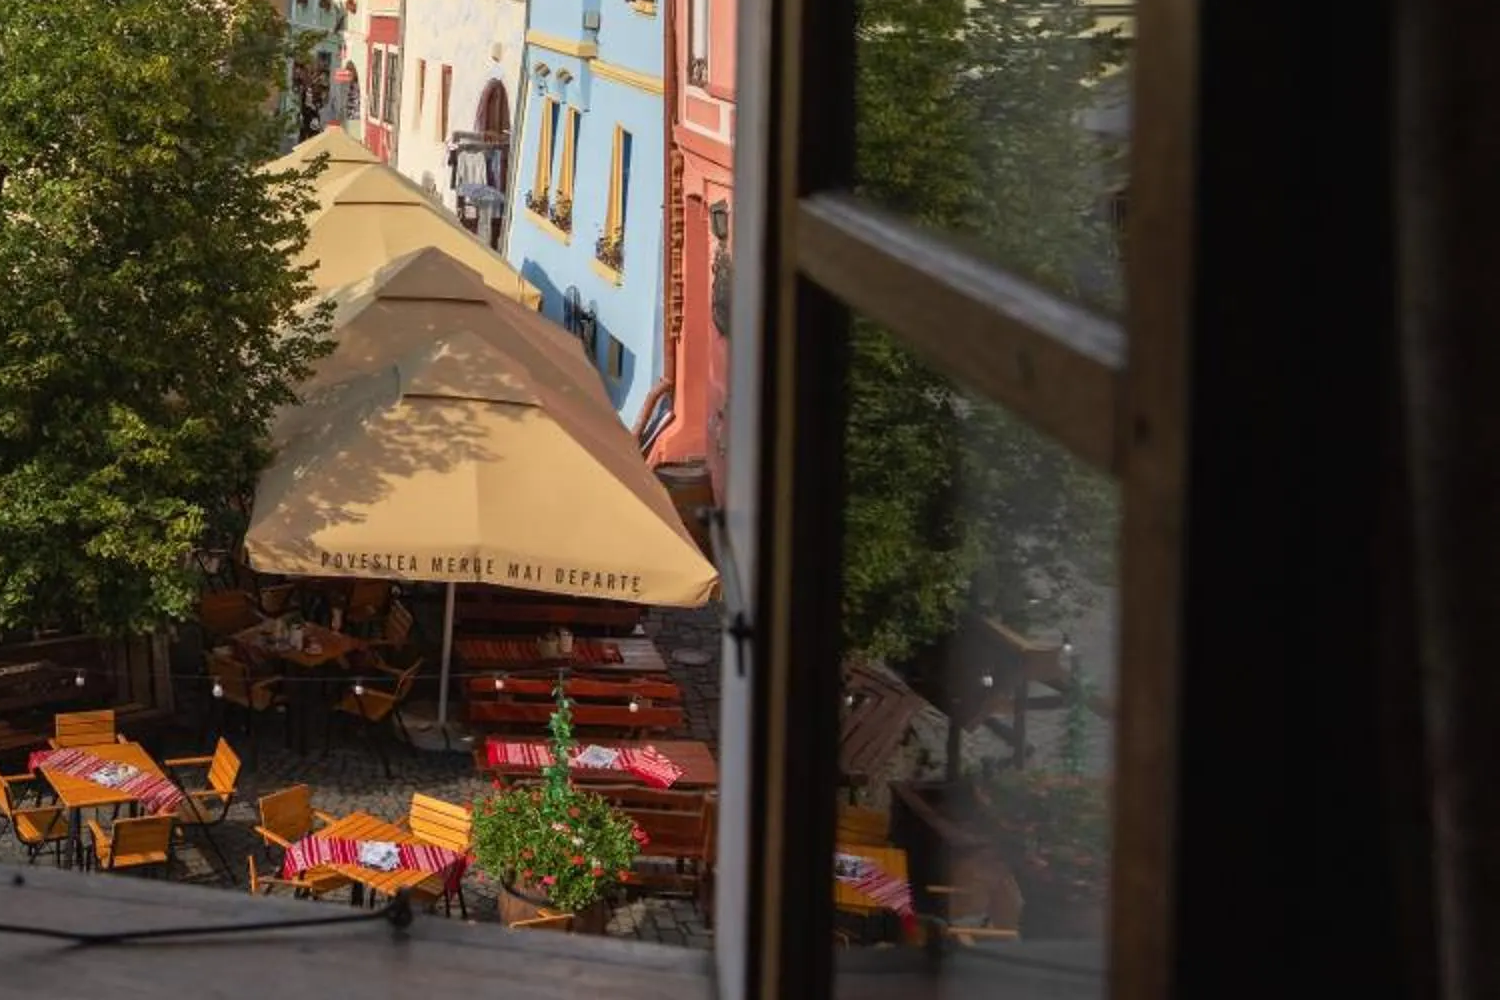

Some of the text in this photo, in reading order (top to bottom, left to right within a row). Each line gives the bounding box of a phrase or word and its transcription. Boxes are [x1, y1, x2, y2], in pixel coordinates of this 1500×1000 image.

[321, 551, 418, 572] POVESTEA
[507, 563, 542, 581] MAI
[555, 567, 641, 592] DEPARTE
